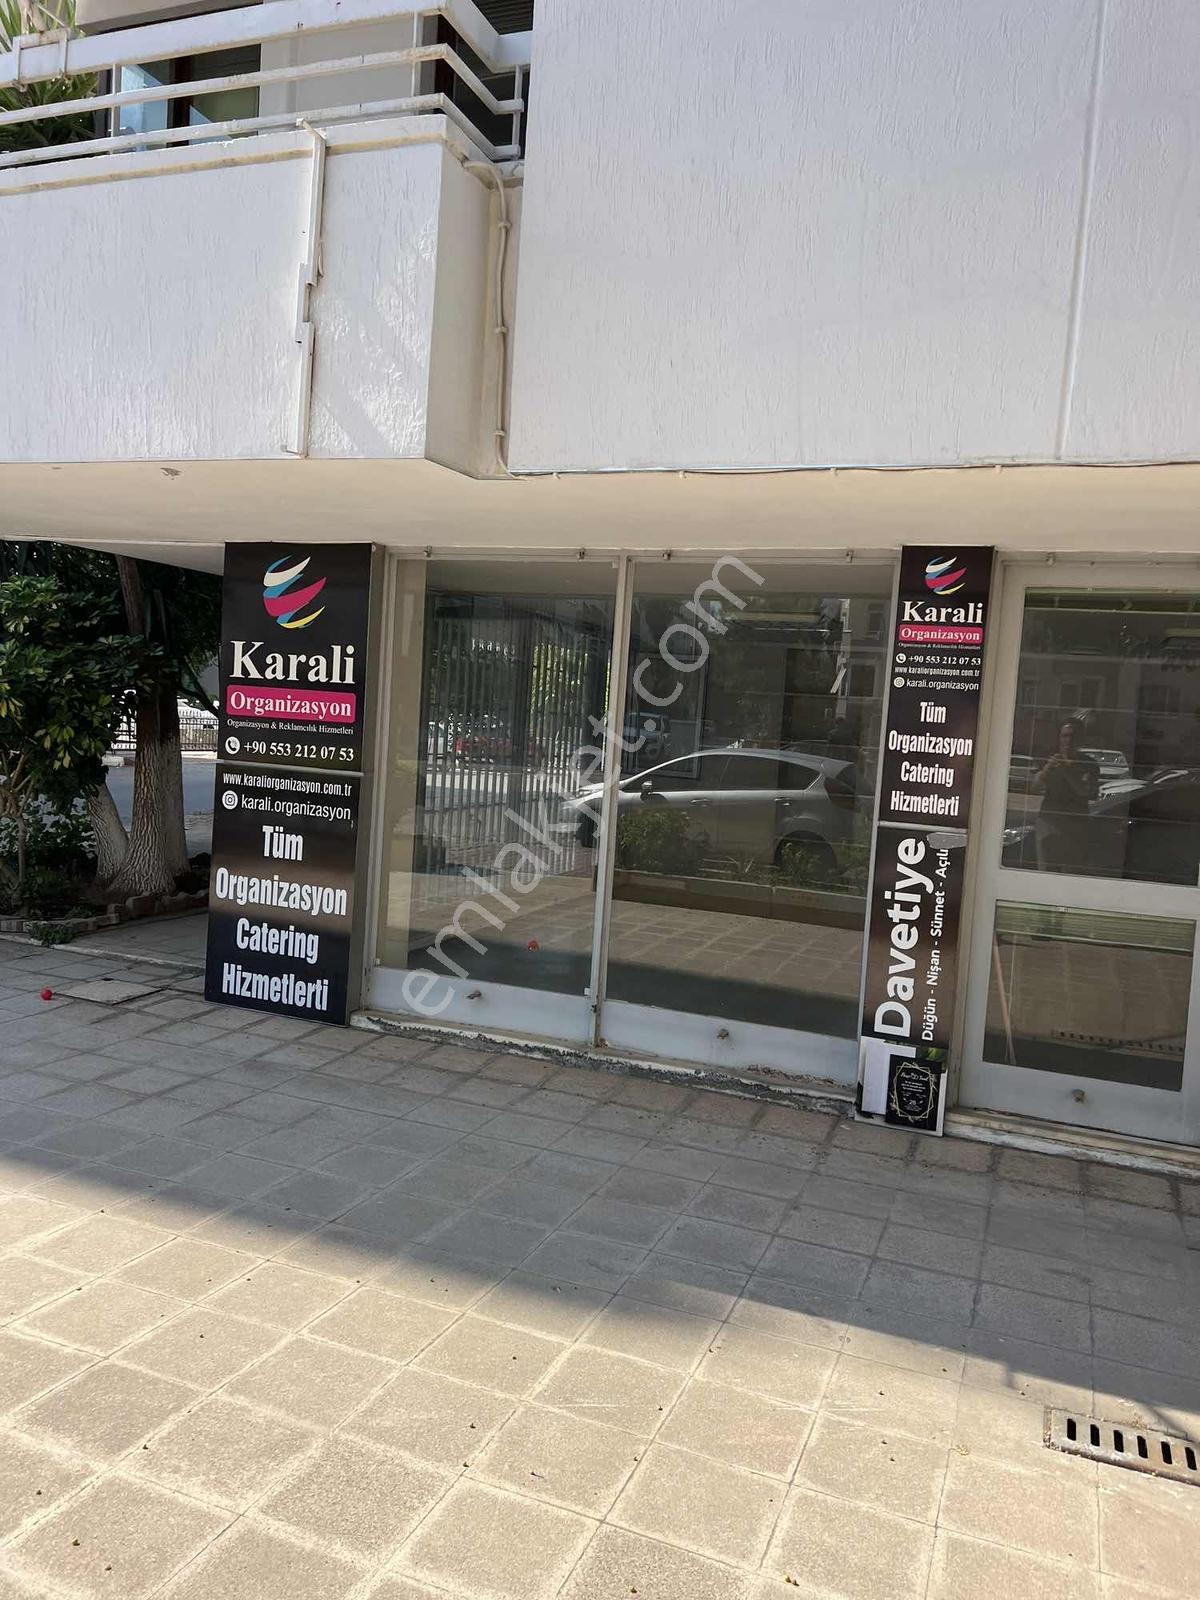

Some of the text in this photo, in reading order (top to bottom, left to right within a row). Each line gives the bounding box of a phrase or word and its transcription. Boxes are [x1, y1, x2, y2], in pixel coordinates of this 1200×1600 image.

[902, 601, 983, 624] Karali
[901, 627, 980, 643] Organizasyon
[229, 640, 355, 684] Karali
[908, 655, 981, 666] +90 553 212 07 53
[906, 678, 979, 692] karali.organizasyon
[230, 691, 351, 719] Organizasyon
[920, 701, 947, 724] Tüm
[227, 718, 269, 730] Organizasyon
[319, 725, 353, 735] Hizmetleri
[244, 741, 354, 761] +90 553 212 07 53
[888, 730, 973, 757] Organizasyon
[223, 773, 352, 796] www.karaliorganizasyon.com.tr
[900, 761, 954, 788] Catering
[241, 794, 351, 821] karali.organizasyon
[890, 790, 960, 817] Hizmetlerti
[262, 825, 303, 861] Tüm
[935, 849, 951, 878] Açılı
[216, 867, 347, 916] Organizasyon
[930, 890, 946, 937] Sünnet
[236, 917, 319, 964] Catering
[874, 838, 934, 1037] Davetiye
[926, 949, 942, 986] Nişan
[222, 962, 329, 1011] Hizmetlerti
[921, 998, 938, 1041] Düğün
